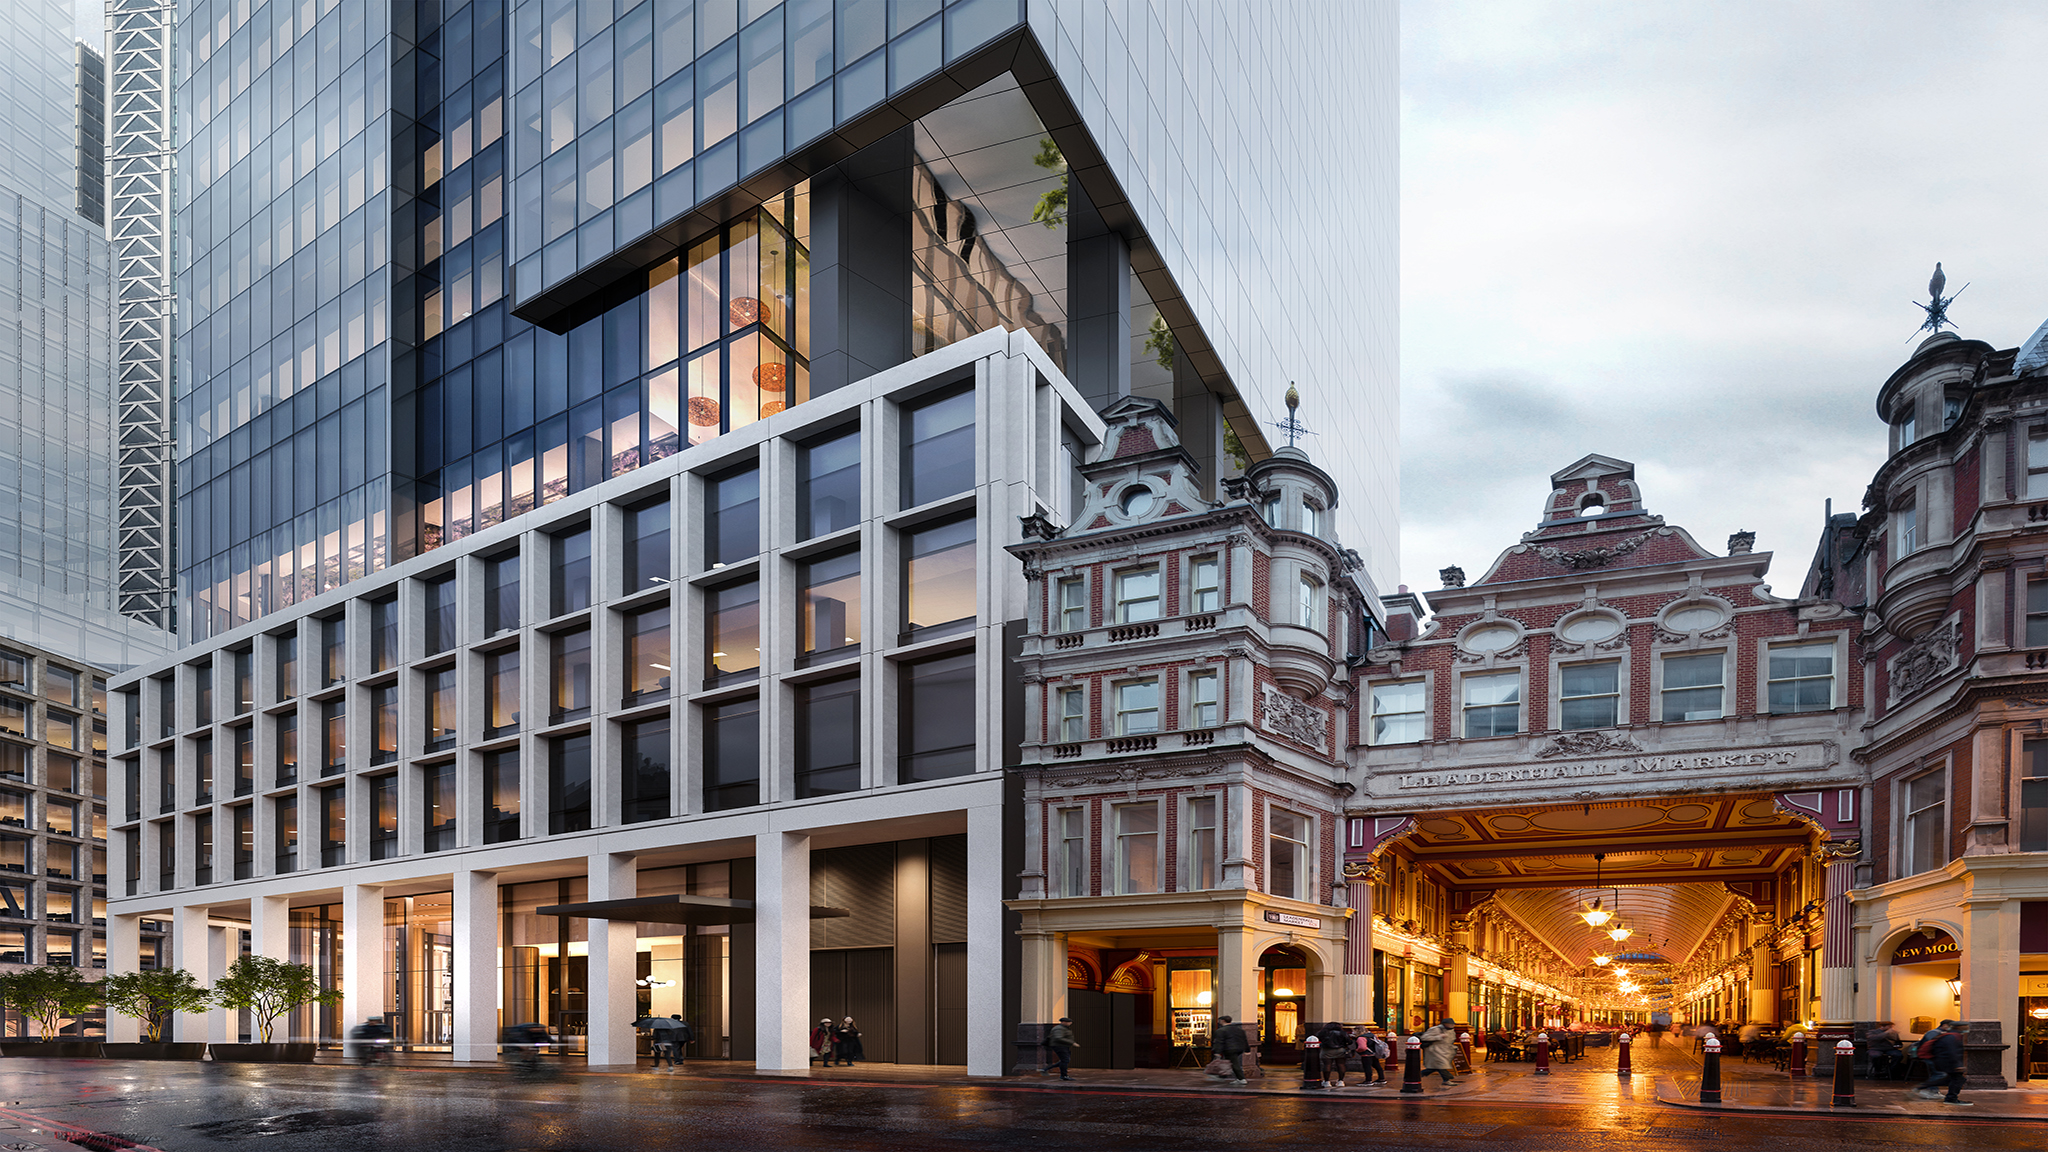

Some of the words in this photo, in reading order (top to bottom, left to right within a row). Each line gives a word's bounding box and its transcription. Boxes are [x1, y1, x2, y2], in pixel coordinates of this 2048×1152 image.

[1398, 764, 1617, 789] LEADENHALL
[1632, 751, 1796, 773] MARKET
[1894, 947, 1922, 958] NEW
